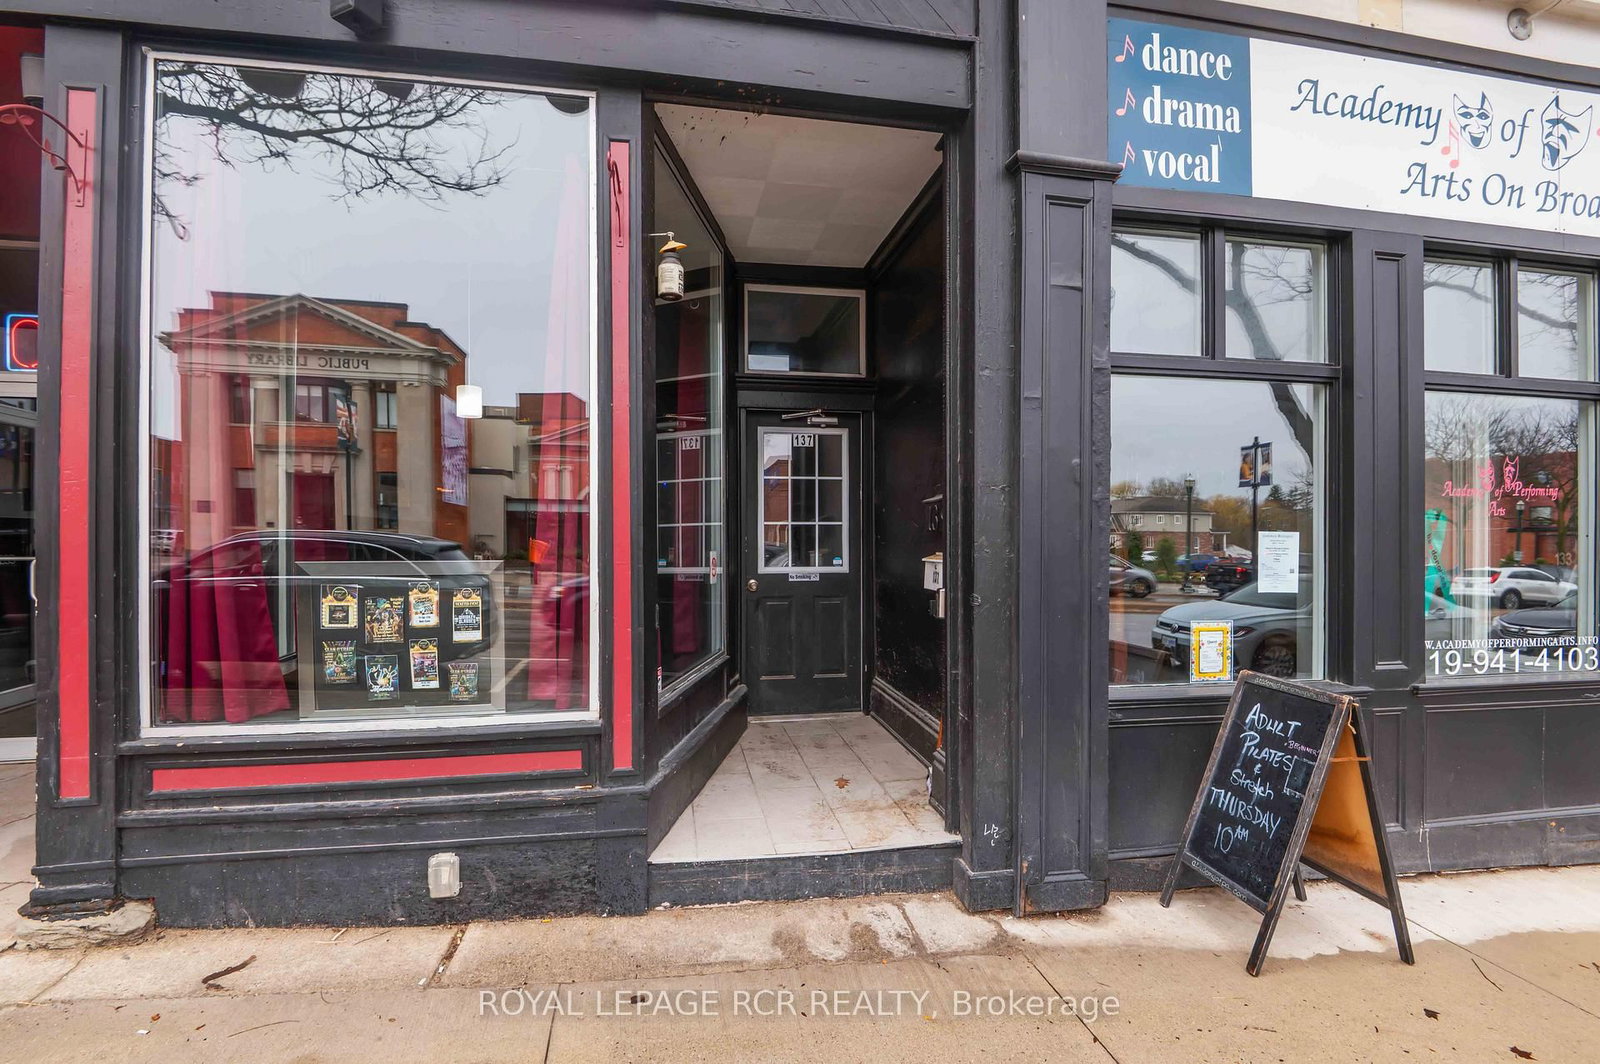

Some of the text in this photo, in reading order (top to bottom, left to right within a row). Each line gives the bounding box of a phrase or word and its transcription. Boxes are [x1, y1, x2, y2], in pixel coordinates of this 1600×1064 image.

[1142, 32, 1232, 80] dance
[1142, 85, 1241, 134] drama
[1290, 78, 1535, 159] Academy of
[1142, 144, 1220, 183] vocal
[1400, 162, 1472, 202] Arts
[1481, 173, 1526, 209] On
[794, 434, 812, 446] 137
[1489, 501, 1506, 516] Arts
[1494, 485, 1505, 501] of
[1512, 481, 1559, 501] Performing
[1554, 552, 1573, 566] 133
[1425, 636, 1599, 650] W.ACADEMYOFPERFORMINGARTS.INFO
[1429, 646, 1599, 675] 19-941-4103
[1245, 703, 1301, 738] ADULT
[1240, 731, 1293, 771] PILATES
[1230, 768, 1274, 800] Stretch
[1210, 786, 1281, 839] THURSDAY
